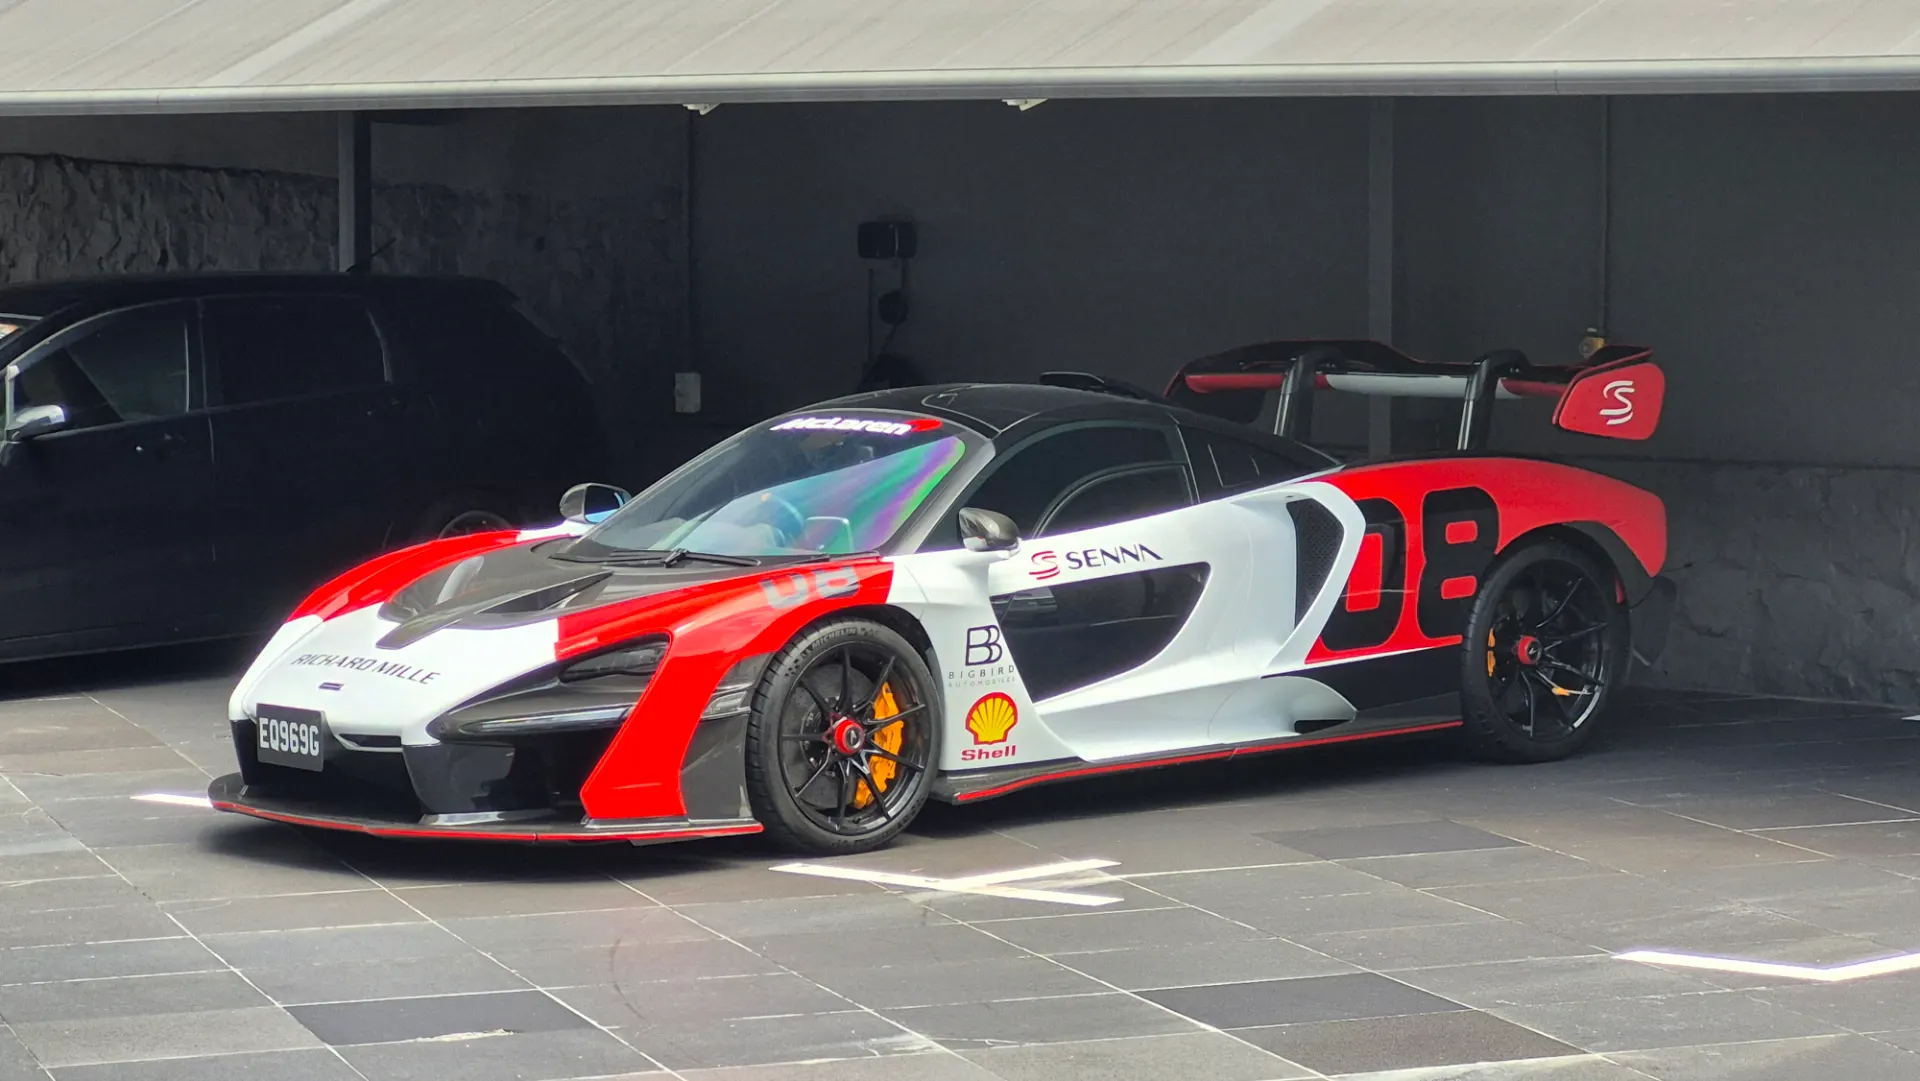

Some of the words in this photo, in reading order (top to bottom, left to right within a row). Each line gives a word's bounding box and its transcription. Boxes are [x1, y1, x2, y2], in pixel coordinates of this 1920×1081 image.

[769, 417, 912, 436] McLaren
[1065, 543, 1164, 570] SENNA
[1319, 484, 1500, 653] 08
[811, 626, 858, 650] MICHELIN
[291, 653, 377, 671] RICHARD
[372, 661, 441, 685] MILLE
[258, 717, 320, 757] EQ969G
[961, 744, 1017, 761] Shell
